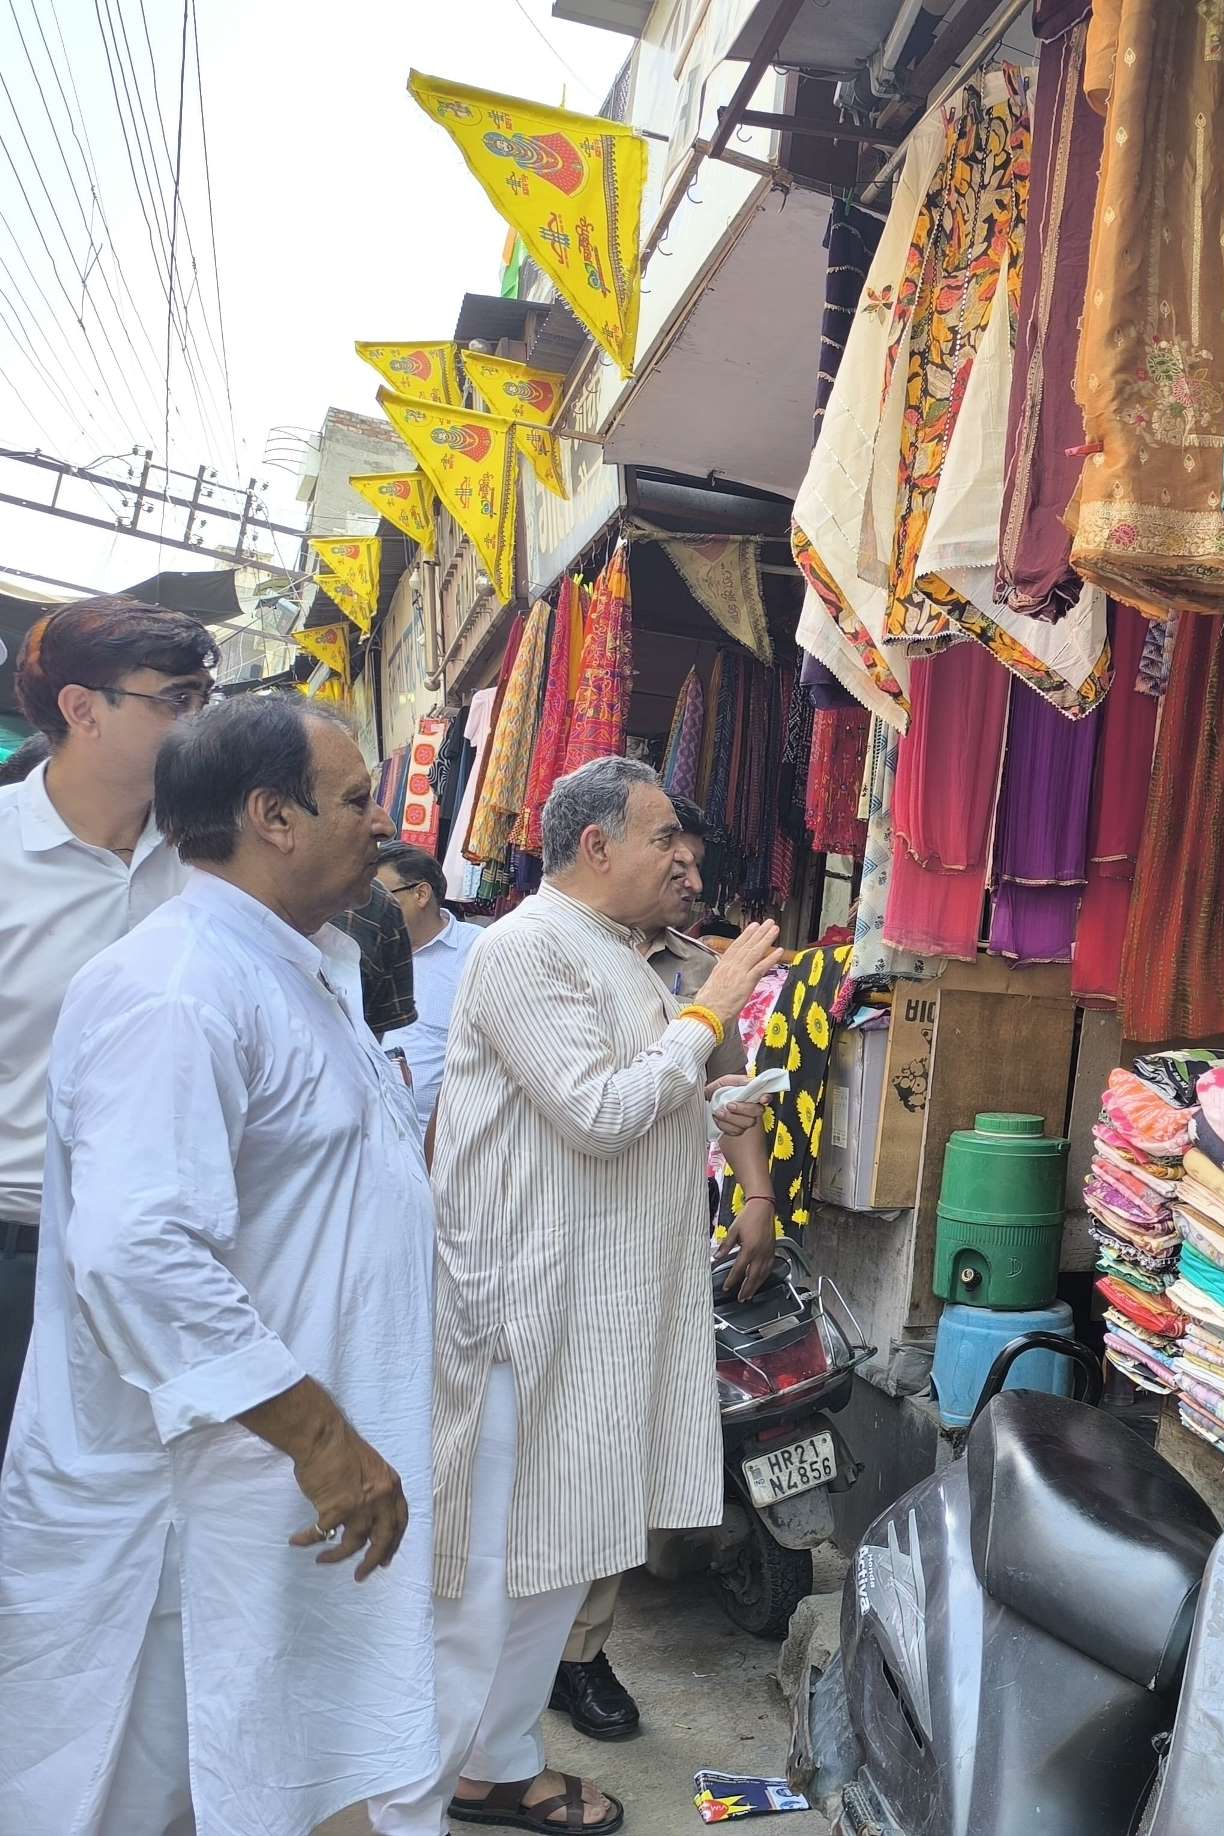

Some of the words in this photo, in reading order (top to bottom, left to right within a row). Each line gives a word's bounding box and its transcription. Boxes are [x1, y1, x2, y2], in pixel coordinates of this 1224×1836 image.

[767, 1439, 820, 1476] HR21
[768, 1457, 832, 1497] N4856
[858, 1545, 870, 1616] Activa
[868, 1553, 876, 1588] Honda
